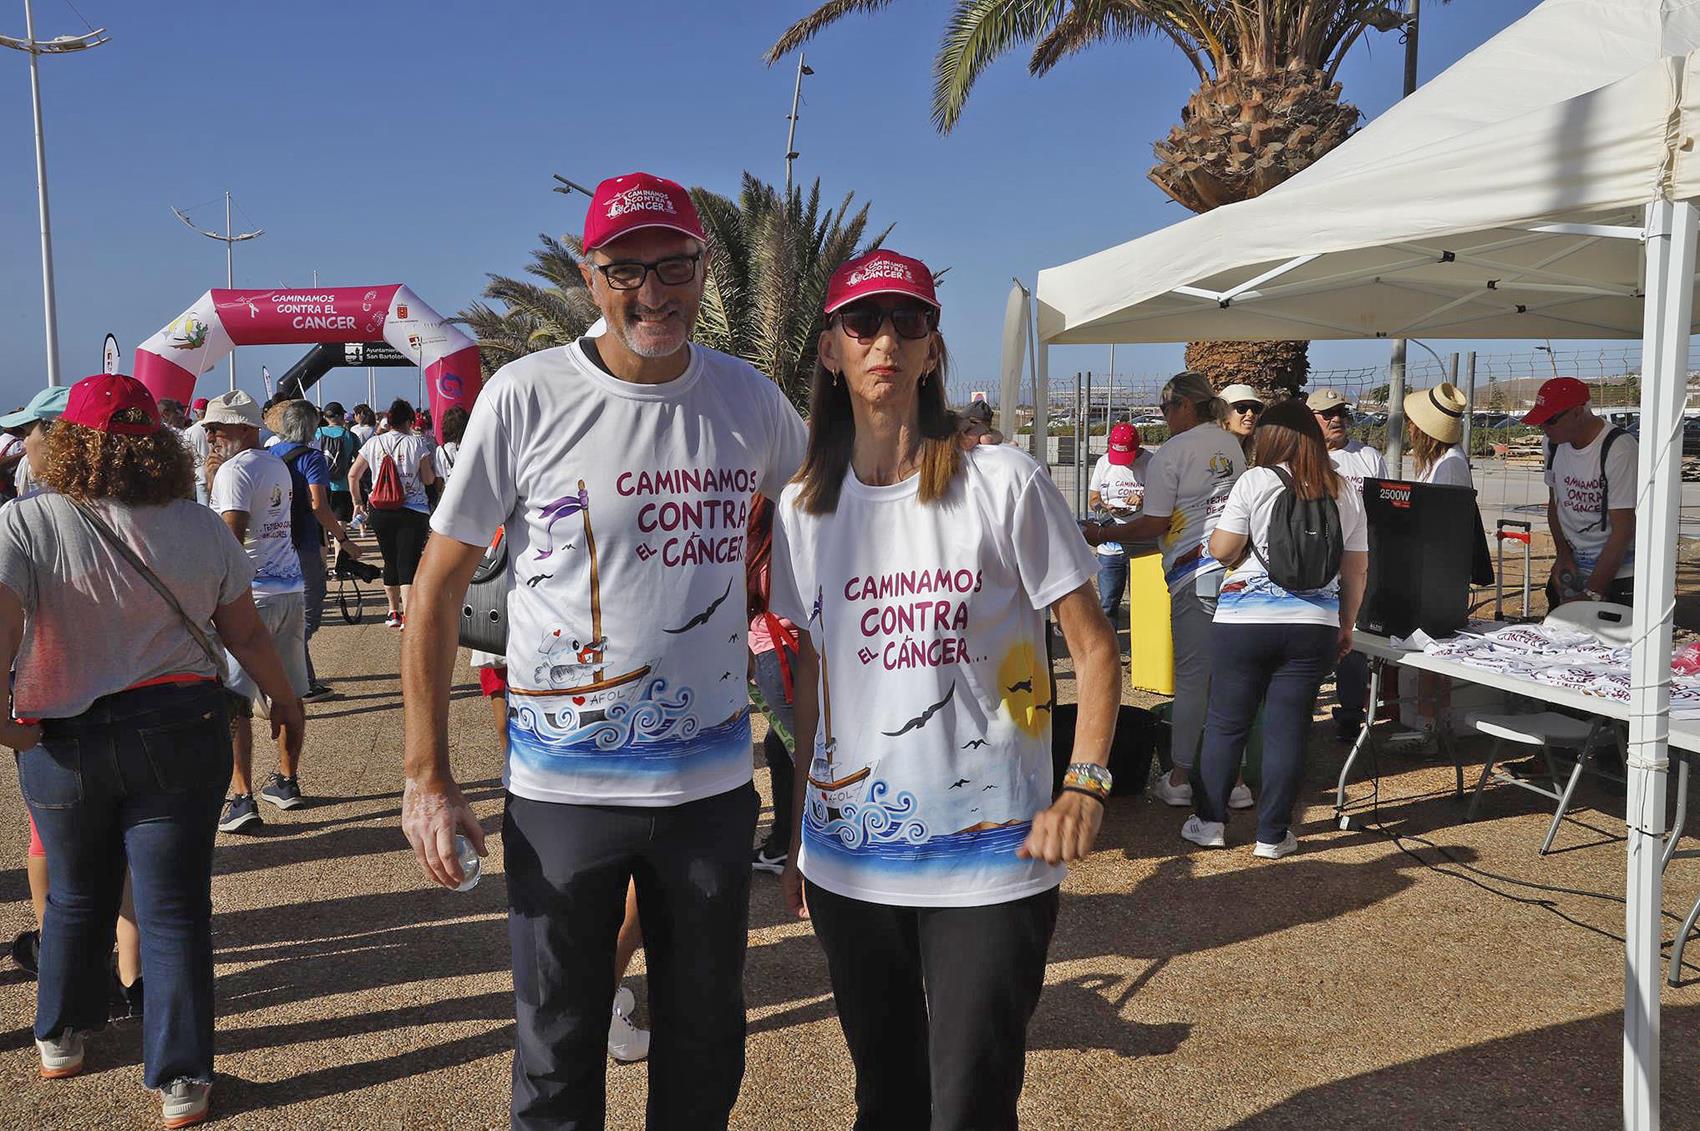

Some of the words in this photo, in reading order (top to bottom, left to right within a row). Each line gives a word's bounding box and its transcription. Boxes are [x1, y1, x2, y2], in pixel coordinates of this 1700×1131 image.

[628, 189, 669, 200] CAMINAMOS
[632, 195, 665, 204] CONTRA
[623, 202, 665, 214] CANCER
[862, 270, 903, 280] CANCER
[871, 265, 904, 274] CONTRA
[271, 294, 335, 303] CAMINAMOS
[276, 304, 322, 314] CONTRA
[324, 304, 337, 314] EL
[292, 316, 357, 329] CANCER
[616, 468, 757, 497] CAMINAMOS
[1379, 488, 1411, 502] 2500W
[1567, 488, 1603, 504] ONTRA
[637, 500, 746, 533] CONTRA
[635, 542, 658, 562] EL
[662, 531, 744, 568] CÁNCER
[844, 568, 982, 601] CAMINAMOS
[860, 600, 968, 637] CONTRA
[857, 646, 879, 665] EL
[590, 690, 626, 705] AFOL
